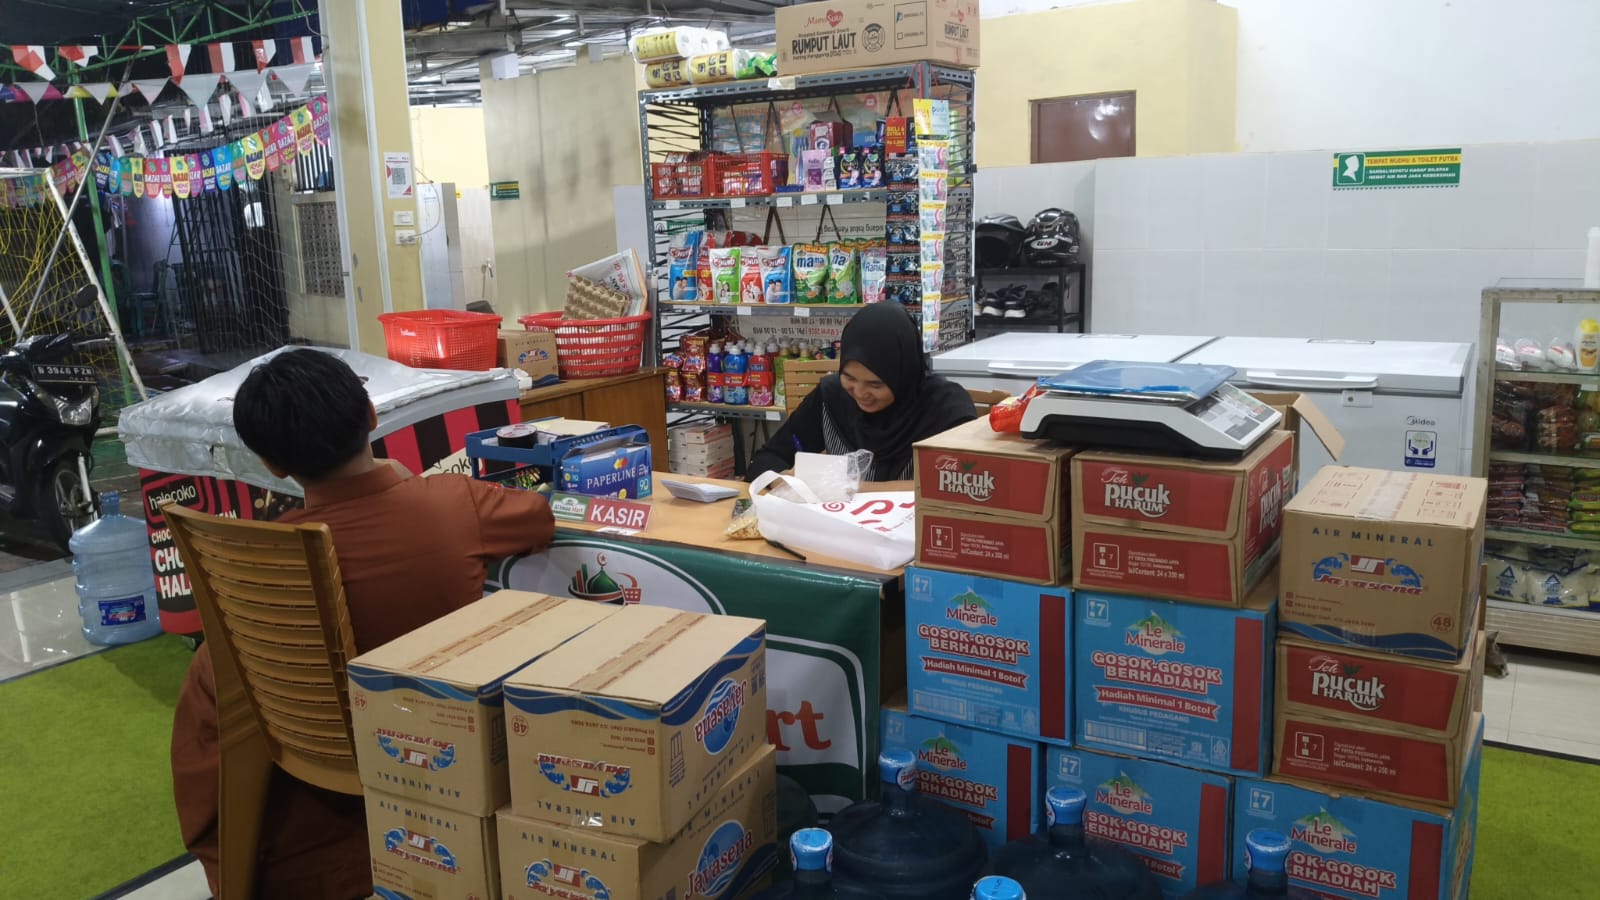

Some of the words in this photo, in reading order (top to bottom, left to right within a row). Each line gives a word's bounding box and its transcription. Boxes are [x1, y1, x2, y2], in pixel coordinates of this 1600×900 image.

[792, 35, 829, 55] RUMPUT
[832, 32, 857, 49] LAUT
[587, 467, 636, 488] PAPERLINE
[948, 484, 992, 501] HARUM
[591, 505, 645, 527] KASIR
[1115, 498, 1168, 518] HARUM
[1312, 527, 1340, 537] AIR
[1351, 531, 1434, 547] MINERAL
[159, 573, 192, 599] HAL
[946, 607, 998, 626] Minerale
[963, 599, 978, 612] Le
[1146, 623, 1162, 638] Le
[1432, 615, 1451, 627] 48
[919, 624, 1029, 652] GOSOK-GOSOK
[1125, 632, 1185, 652] Minerale
[930, 637, 1017, 662] BERHADIAH
[927, 659, 955, 671] Hadiah
[957, 661, 990, 677] Minimal
[998, 671, 1022, 684] Botol
[1093, 652, 1221, 682] GOSOK-GOSOK
[1308, 655, 1339, 674] Teh
[1106, 666, 1206, 691] BERHADIAH
[1101, 689, 1135, 700] Hadiah
[1136, 693, 1175, 708] Minimal
[1185, 702, 1211, 715] Botol
[1323, 688, 1381, 710] HARUM
[918, 749, 967, 770] Minerale
[935, 742, 948, 755] Le
[377, 771, 432, 791] MINERAL
[1115, 782, 1131, 797] Le
[439, 788, 461, 798] AIR
[1096, 790, 1152, 814] Minerale
[380, 800, 398, 812] AIR
[405, 808, 459, 831] MINERAL
[611, 815, 635, 826] AIR
[1088, 811, 1186, 842] SOK-GOSOK
[1313, 817, 1332, 835] Le
[522, 832, 544, 844] AIR
[552, 840, 616, 862] MINERAL
[1086, 823, 1172, 851] ERHADIAH
[1291, 827, 1356, 853] Minerale
[1293, 852, 1396, 886] OK-GOSOK
[1292, 866, 1379, 896] RHADIAH
